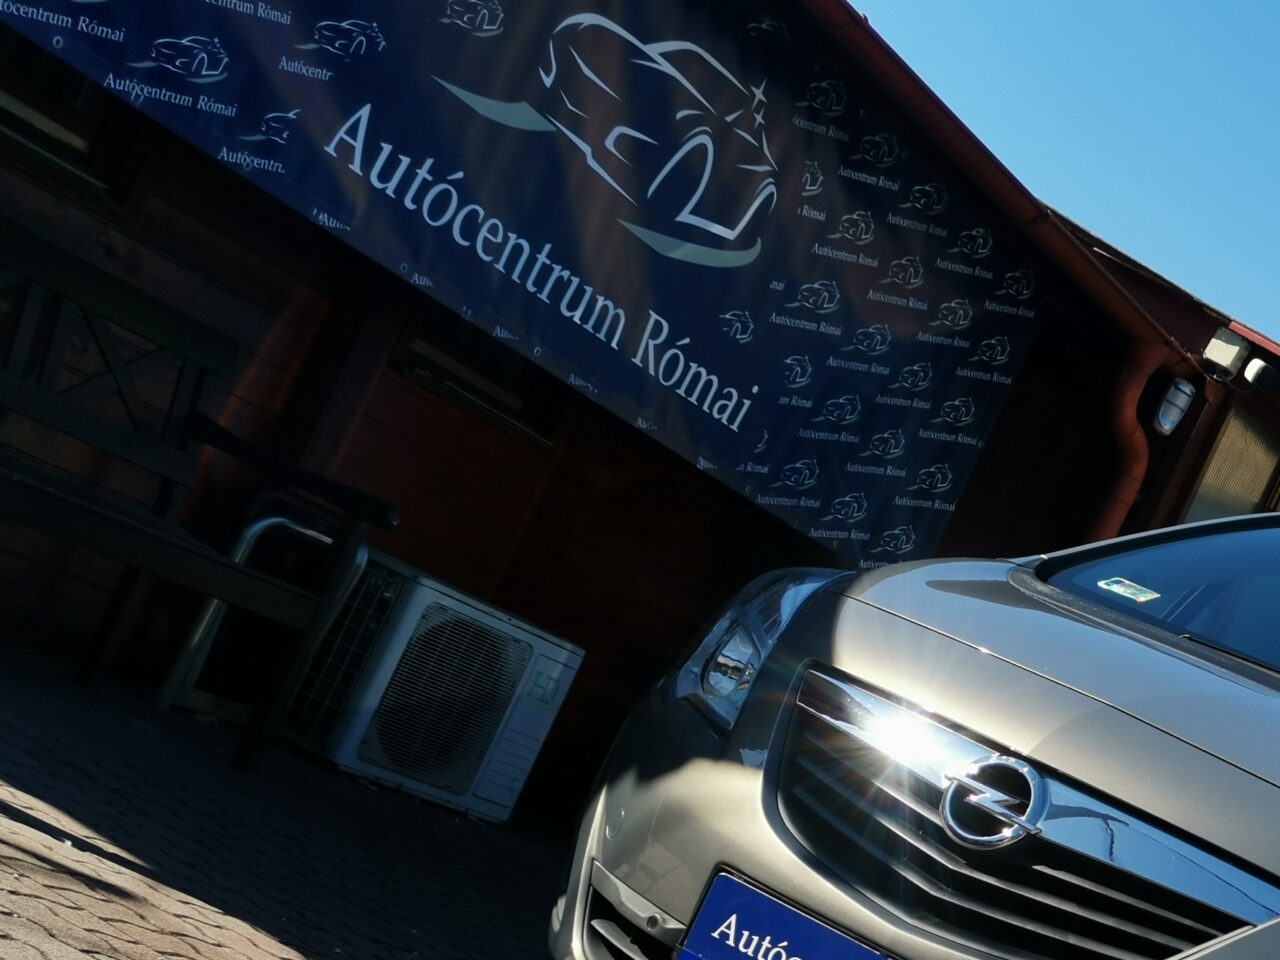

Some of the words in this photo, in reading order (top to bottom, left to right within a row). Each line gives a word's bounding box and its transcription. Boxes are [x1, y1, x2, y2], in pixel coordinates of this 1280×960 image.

[77, 16, 126, 42] Római
[258, 2, 291, 24] Római
[104, 73, 192, 107] Autócentrum
[197, 95, 238, 117] Római
[324, 103, 627, 350] Autócentrum
[631, 310, 759, 432] Római
